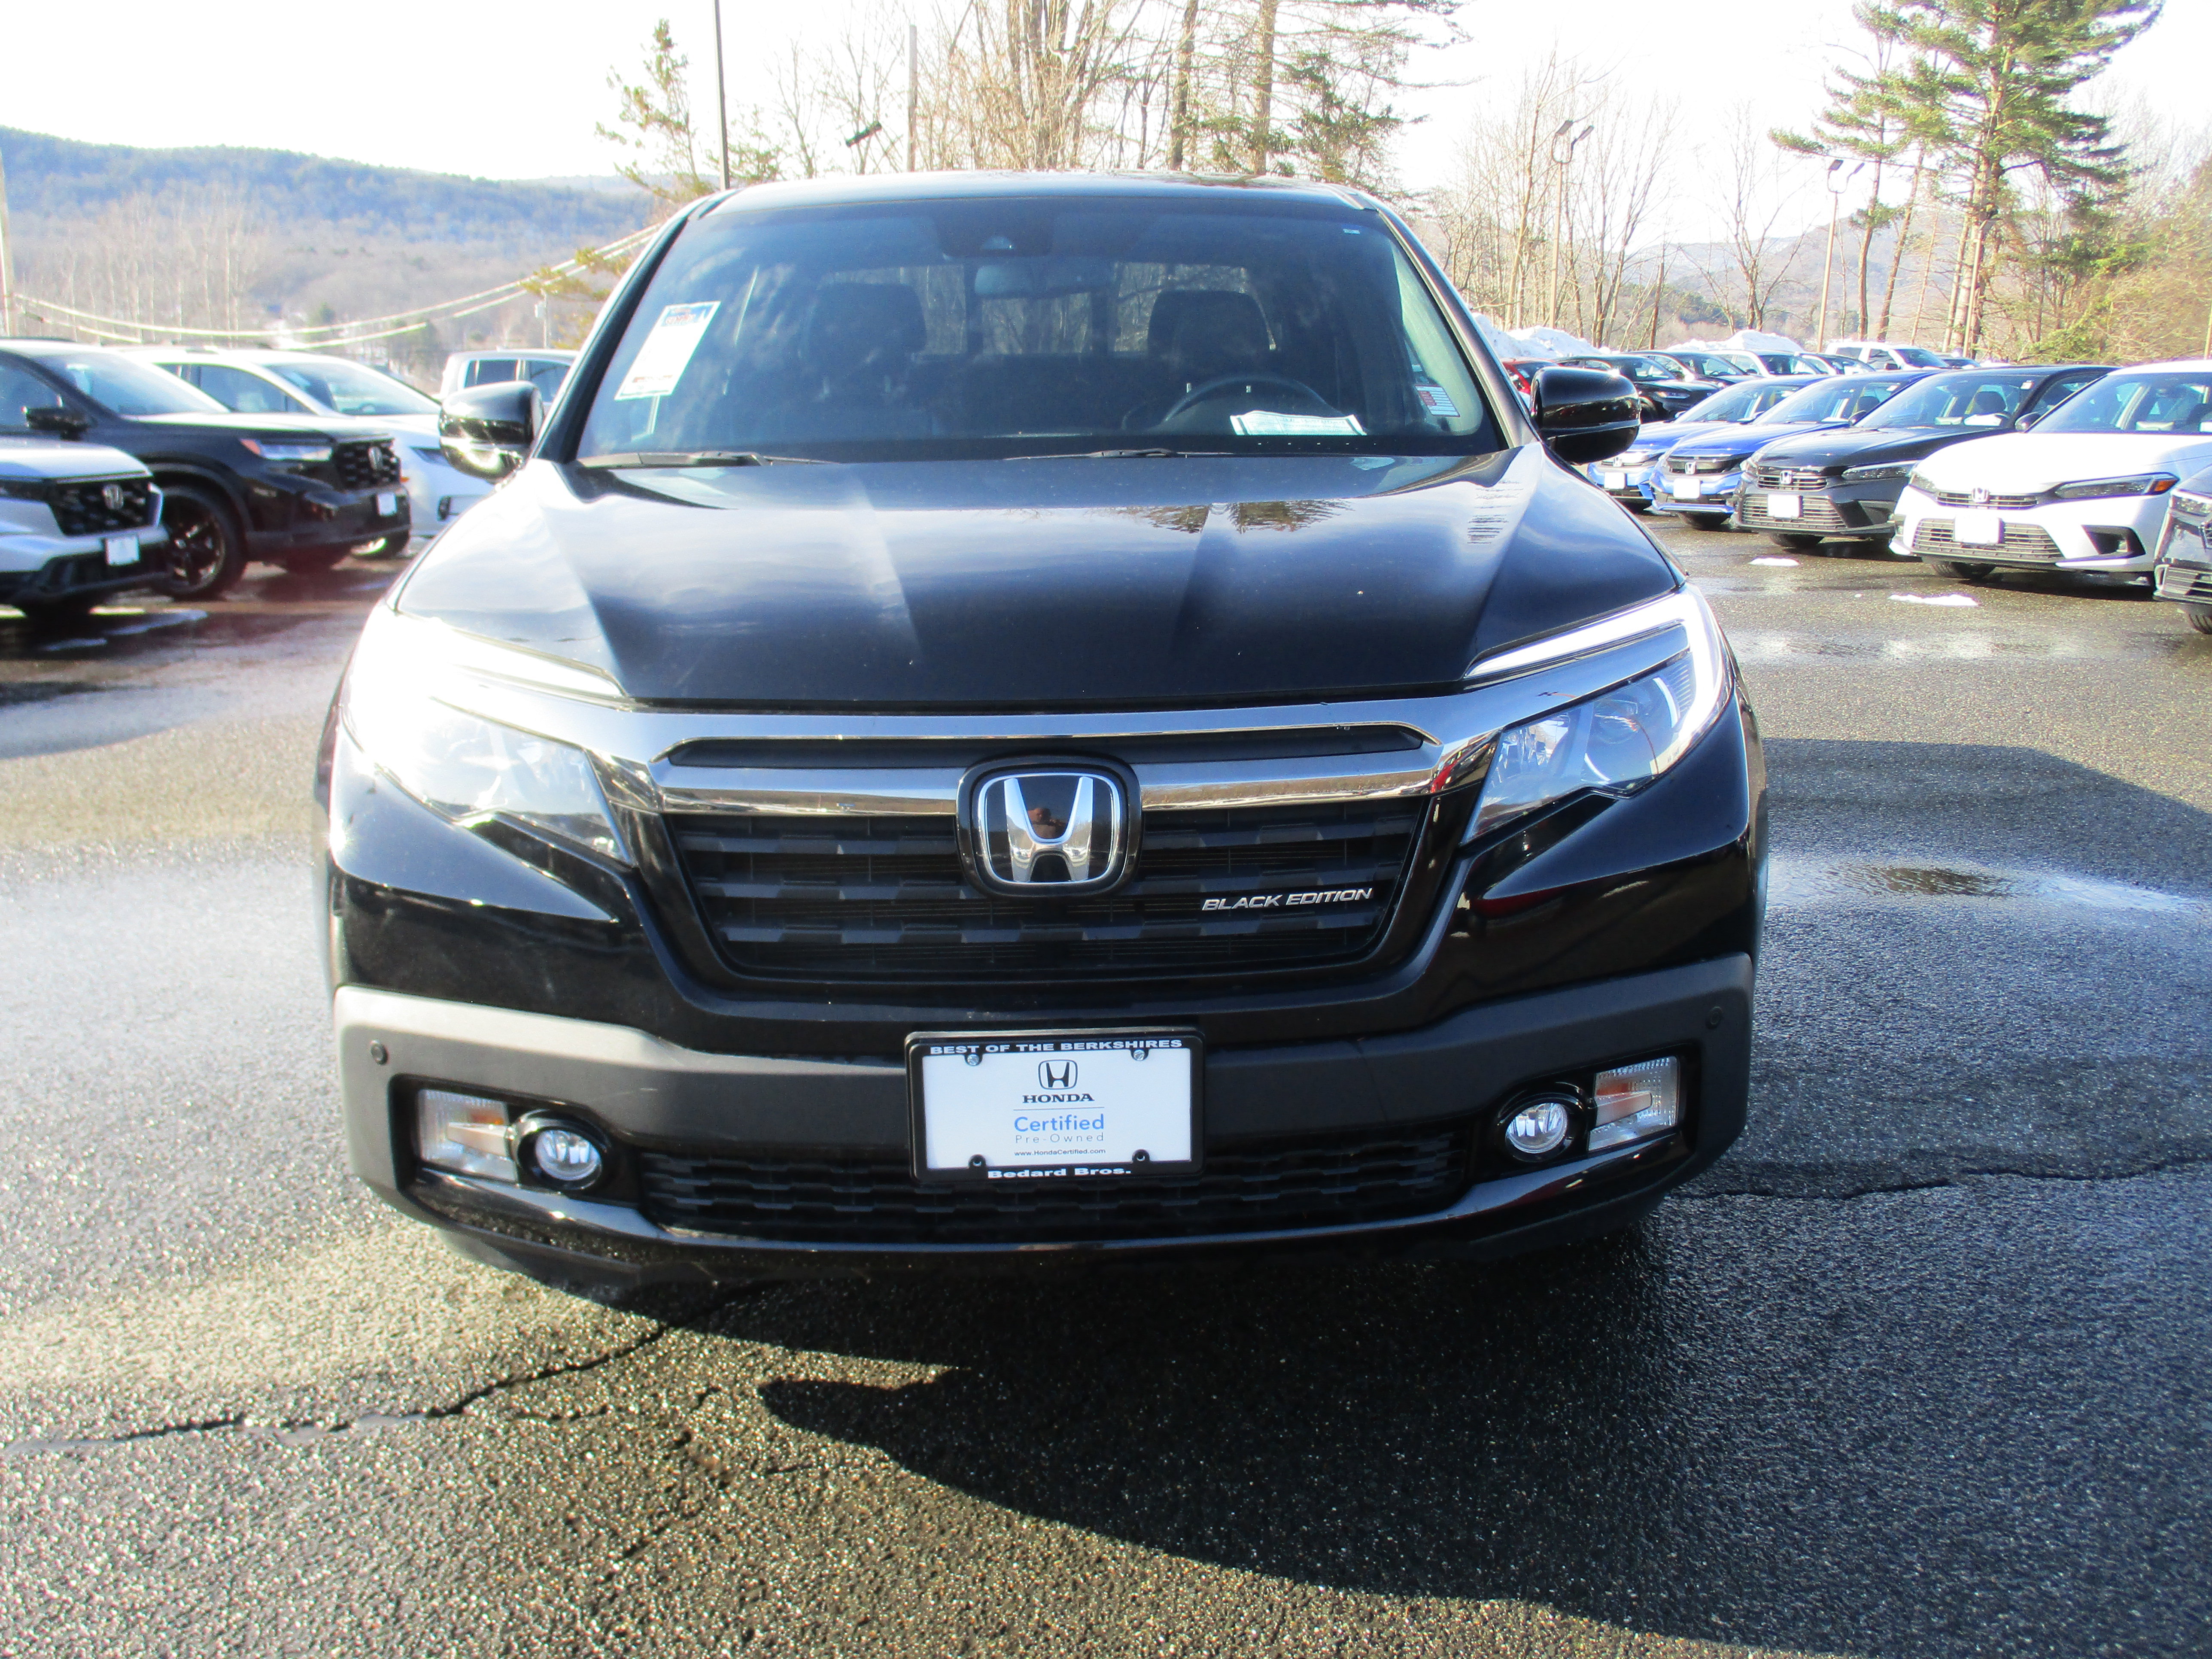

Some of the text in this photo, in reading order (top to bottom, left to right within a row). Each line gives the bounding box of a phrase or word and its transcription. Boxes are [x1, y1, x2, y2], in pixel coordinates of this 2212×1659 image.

[1202, 888, 1373, 911] BLACK EDITION
[930, 1045, 979, 1054] BEST
[1016, 1043, 1054, 1051] THE
[1060, 1039, 1182, 1051] BERKSHIRES
[1022, 1093, 1095, 1103] HONDA
[1014, 1113, 1104, 1132] Certified
[1015, 1132, 1104, 1143] Pre-Owned
[988, 1167, 1131, 1179] Bedard Bros.
